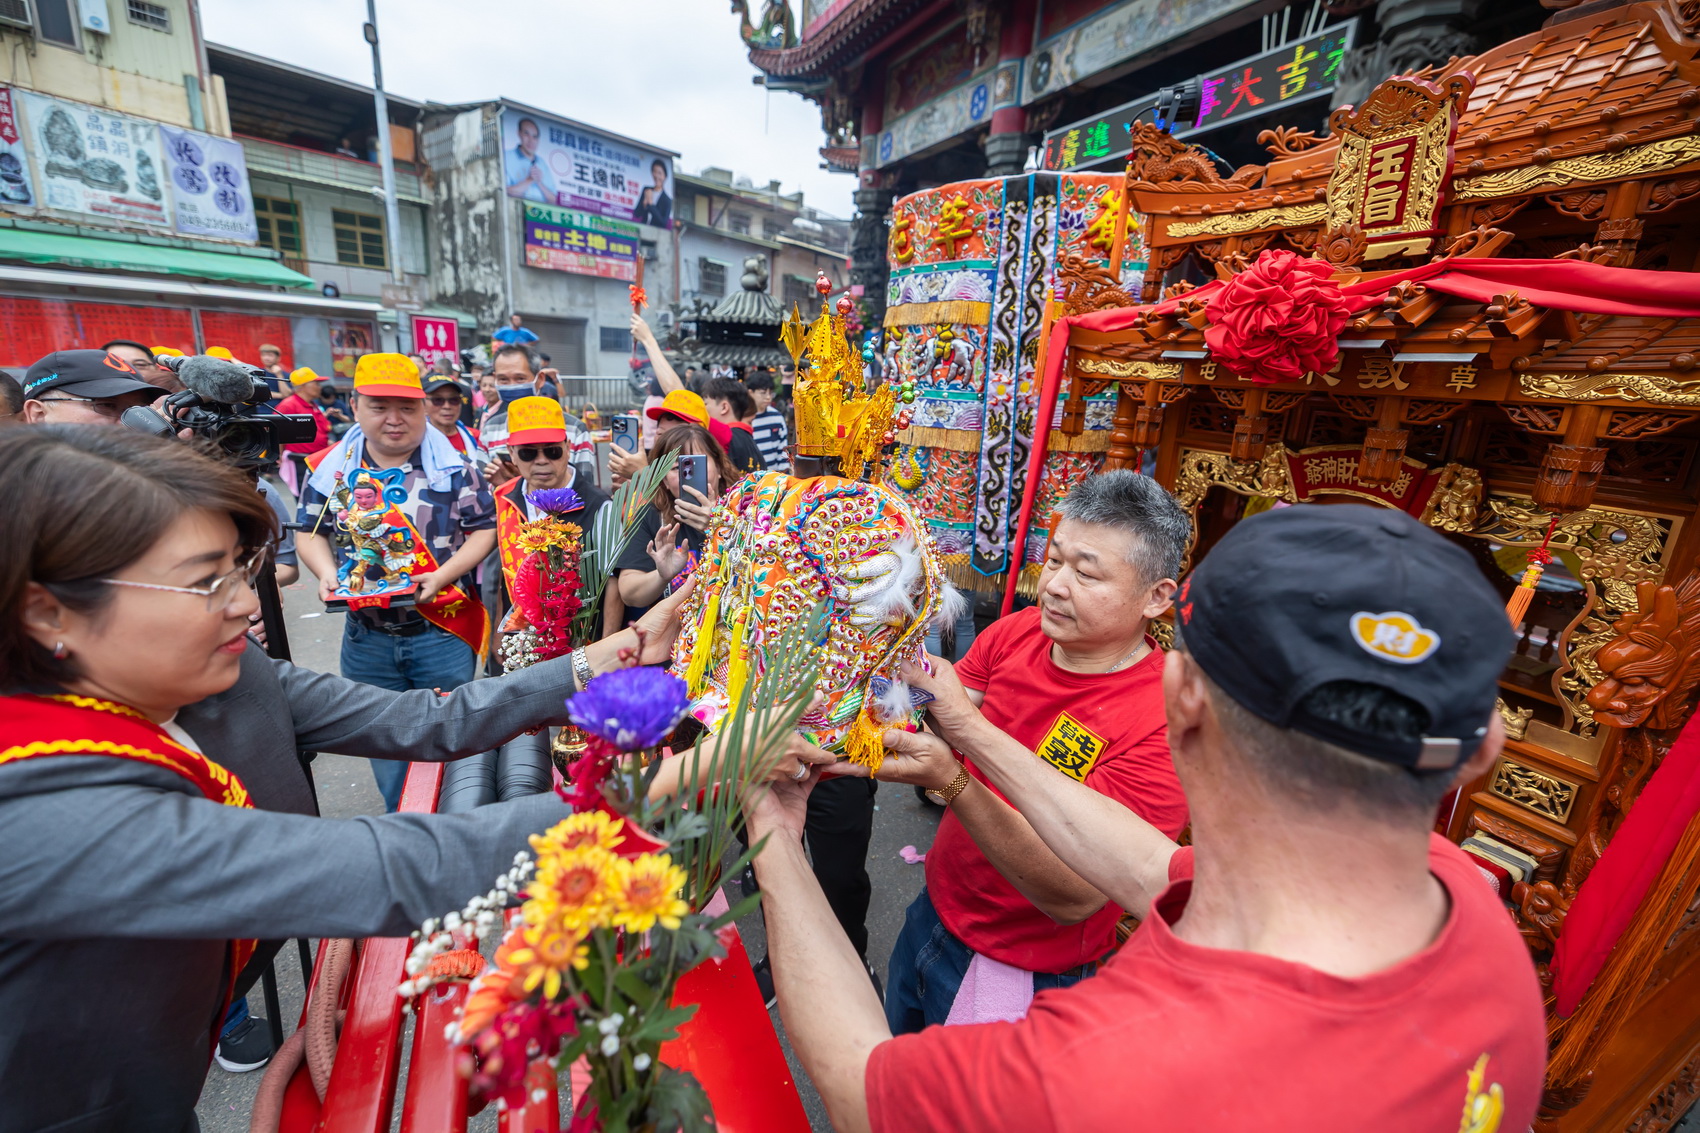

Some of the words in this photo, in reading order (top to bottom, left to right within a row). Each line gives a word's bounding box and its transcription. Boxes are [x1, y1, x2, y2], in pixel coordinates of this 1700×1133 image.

[1362, 142, 1410, 225] 玉旨
[563, 229, 608, 251] 土地
[134, 411, 154, 426] SONY
